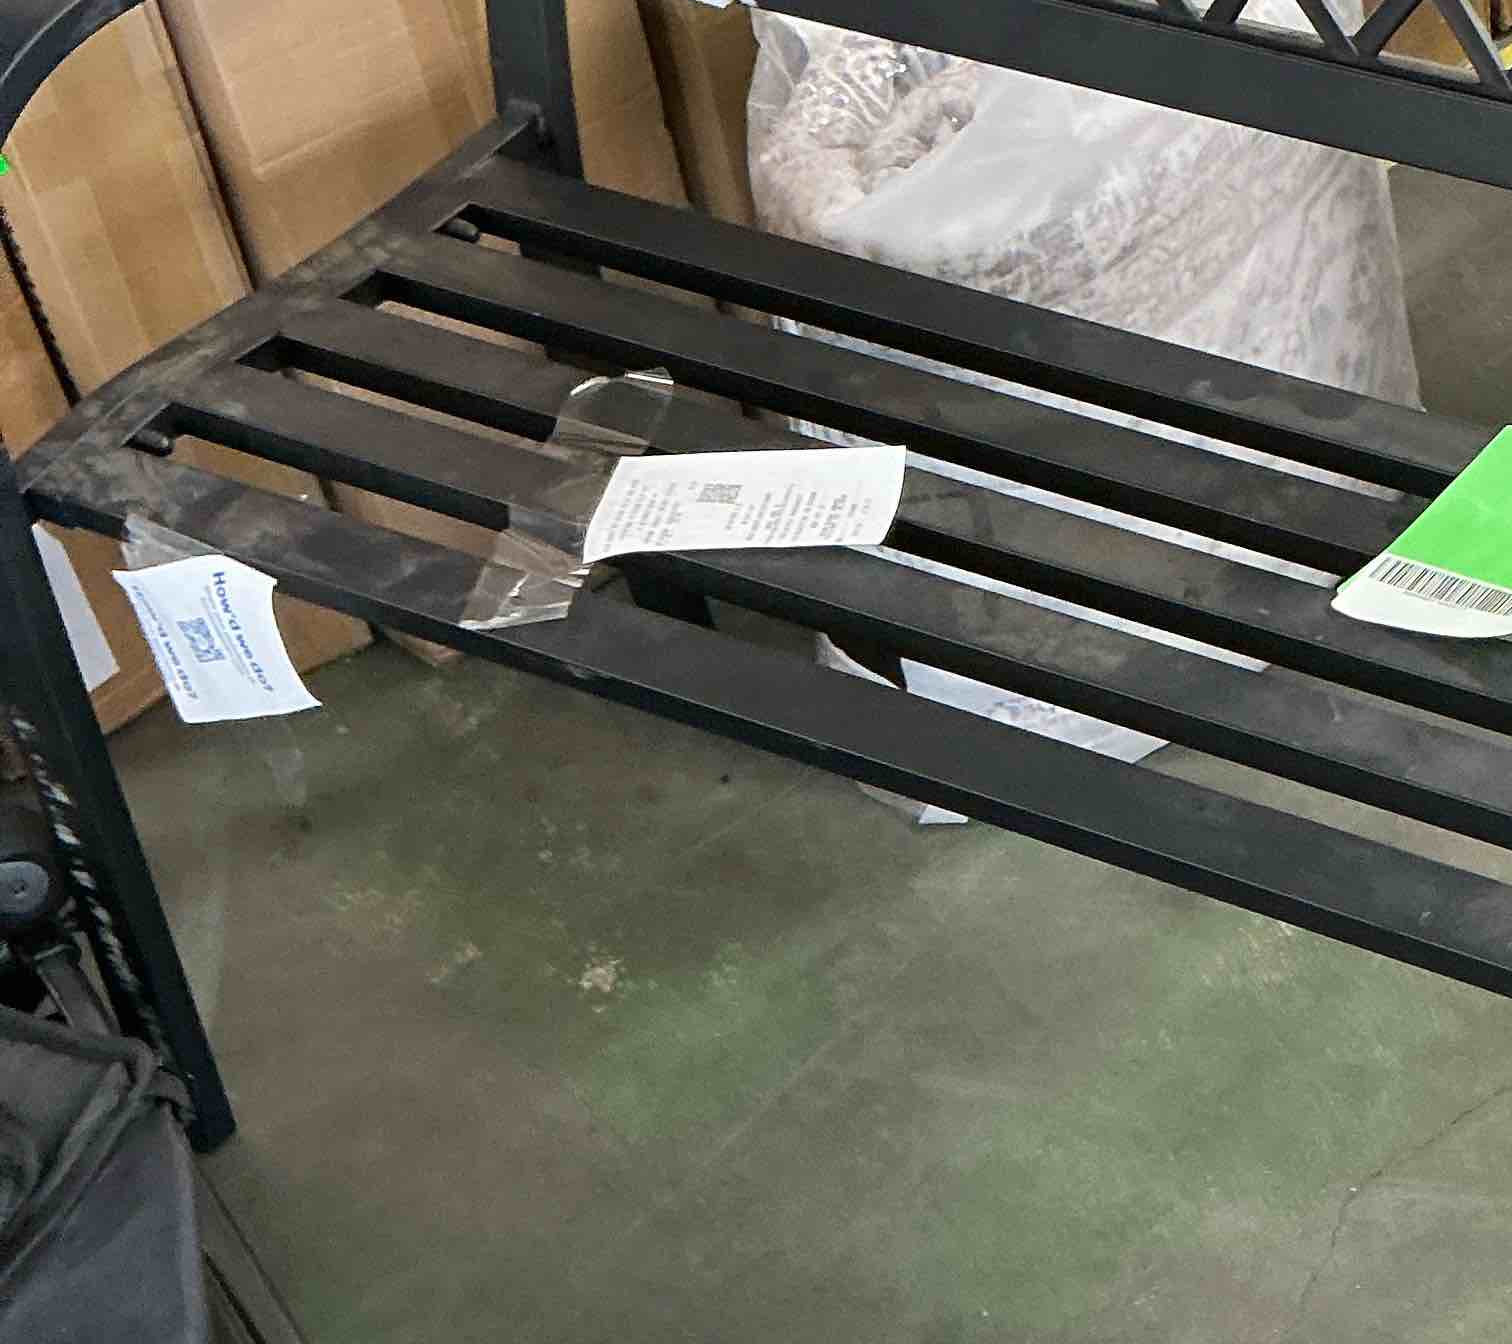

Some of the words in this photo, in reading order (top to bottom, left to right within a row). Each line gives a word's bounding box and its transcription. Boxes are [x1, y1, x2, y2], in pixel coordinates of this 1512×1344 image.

[212, 571, 242, 631] How'd
[236, 634, 253, 659] we
[250, 662, 274, 692] do?
